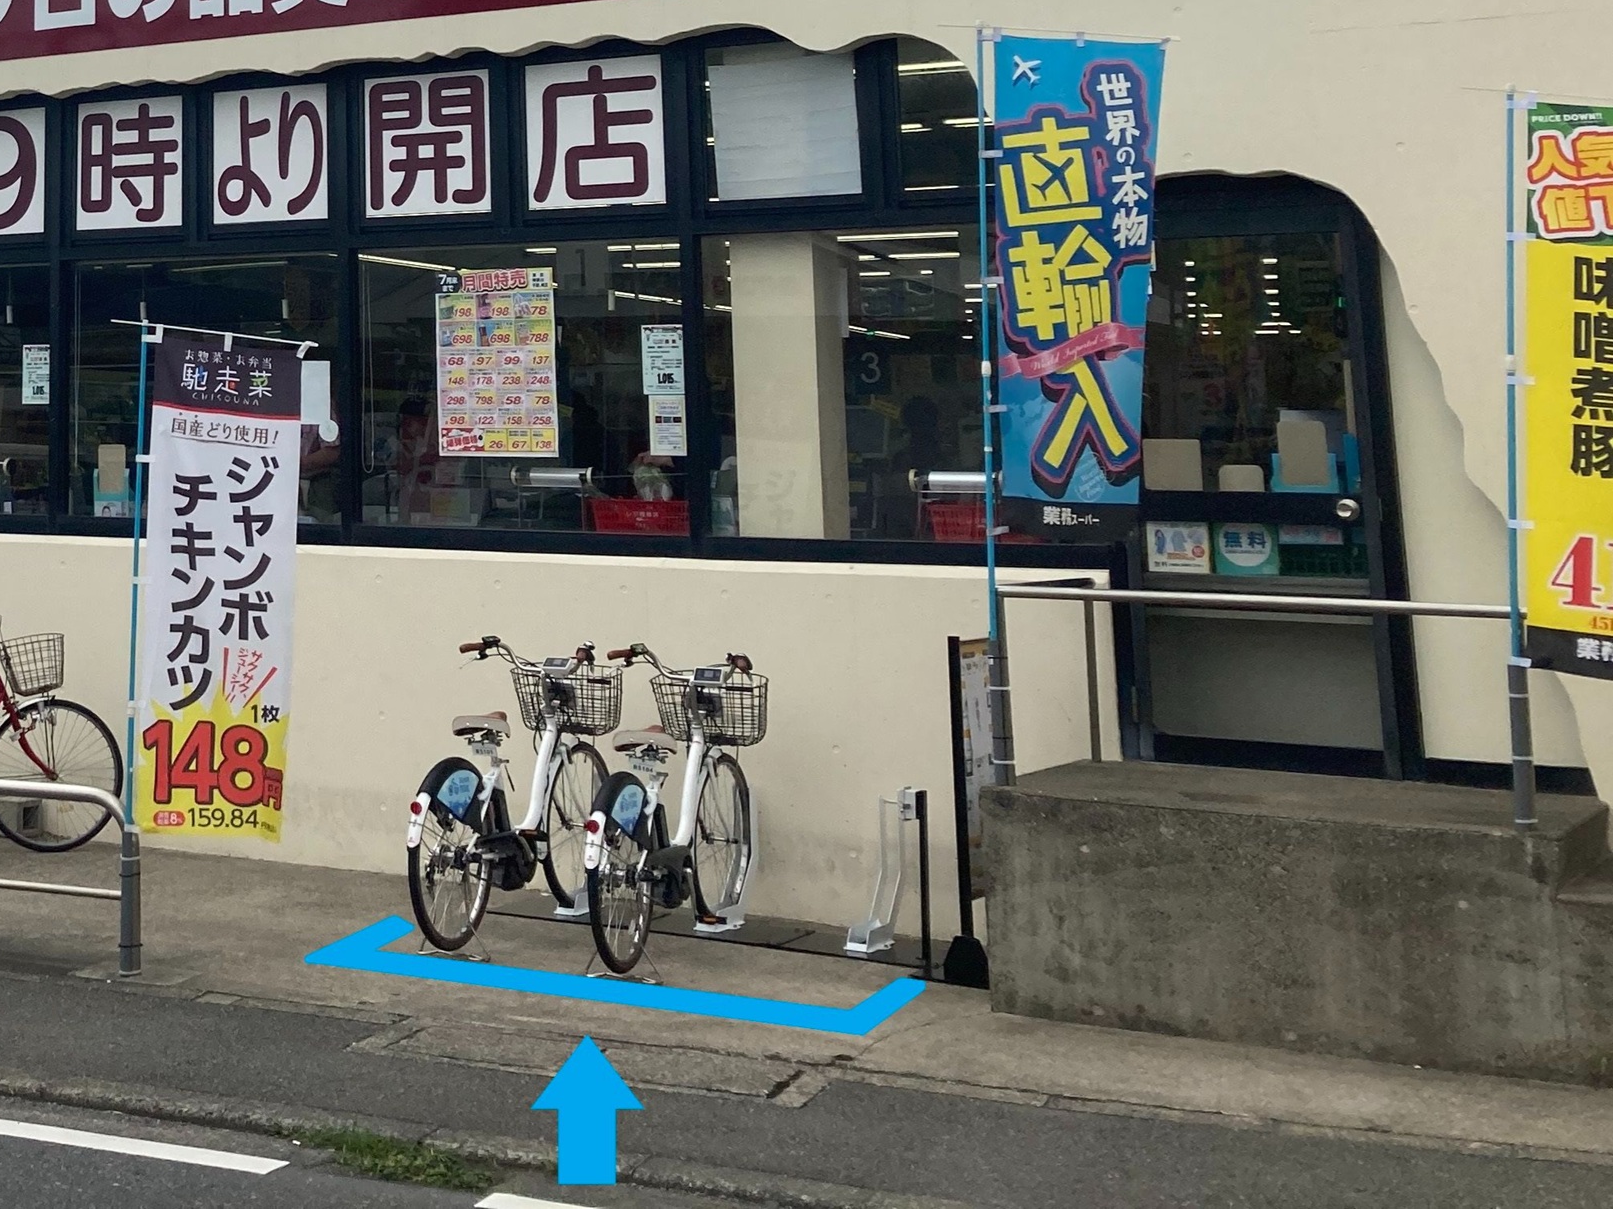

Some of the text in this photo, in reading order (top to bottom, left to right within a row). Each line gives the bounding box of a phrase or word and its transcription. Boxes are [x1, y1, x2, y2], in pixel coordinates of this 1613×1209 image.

[1531, 114, 1562, 123] PRICE
[1096, 73, 1149, 248] 世界の本物
[462, 270, 527, 291] 月間特売
[999, 117, 1129, 468] 直輸入
[491, 307, 510, 316] 198
[531, 306, 547, 315] 78
[452, 335, 473, 343] 698
[490, 334, 510, 343] 698
[185, 349, 272, 370] お惣菜・お弁当
[448, 357, 464, 365] 68
[476, 357, 492, 365] 97
[504, 356, 520, 365] 99
[532, 356, 549, 365] 137
[861, 352, 881, 383] 3
[181, 363, 272, 398] 馳走菜
[505, 396, 521, 404] 58
[535, 396, 550, 405] 78
[450, 416, 465, 425] 98
[489, 440, 503, 449] 26
[512, 440, 527, 449] 67
[1043, 506, 1100, 526] 業務スーパー
[219, 455, 280, 641] ジャンボ
[1551, 536, 1613, 609] 4
[167, 473, 217, 711] チキンカツ
[251, 704, 280, 723] 1枚
[188, 807, 259, 828] 159.84
